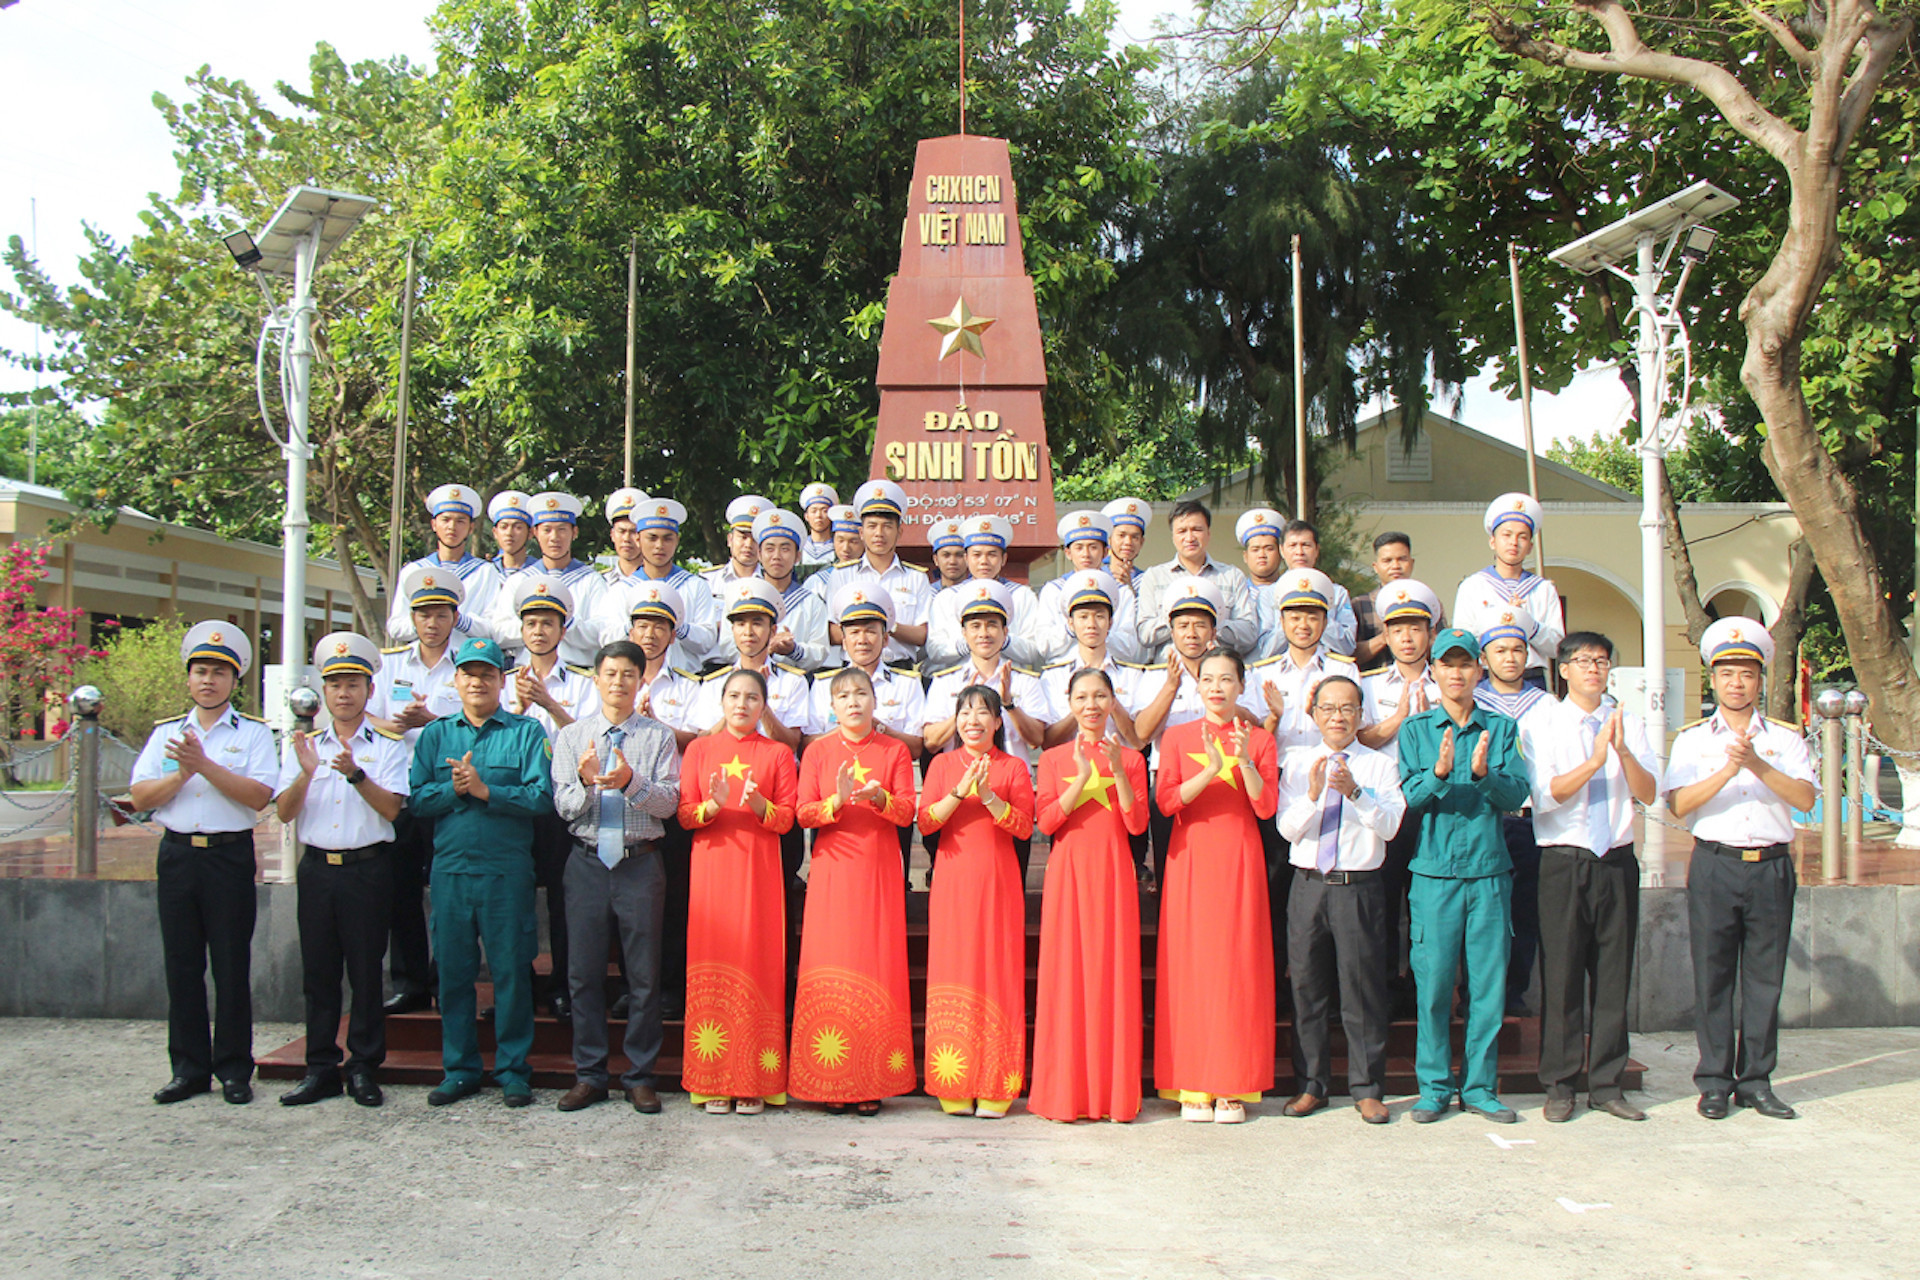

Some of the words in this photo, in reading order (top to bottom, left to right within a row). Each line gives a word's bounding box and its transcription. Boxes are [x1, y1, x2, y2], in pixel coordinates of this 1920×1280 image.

[926, 174, 1001, 203] CHXHCN
[919, 206, 959, 251] VIỆT
[965, 212, 1006, 246] NAM
[923, 404, 1000, 431] ĐẢO
[885, 440, 964, 481] SINH
[972, 429, 1038, 481] TỒN
[1025, 496, 1037, 507] N
[1027, 514, 1037, 525] E
